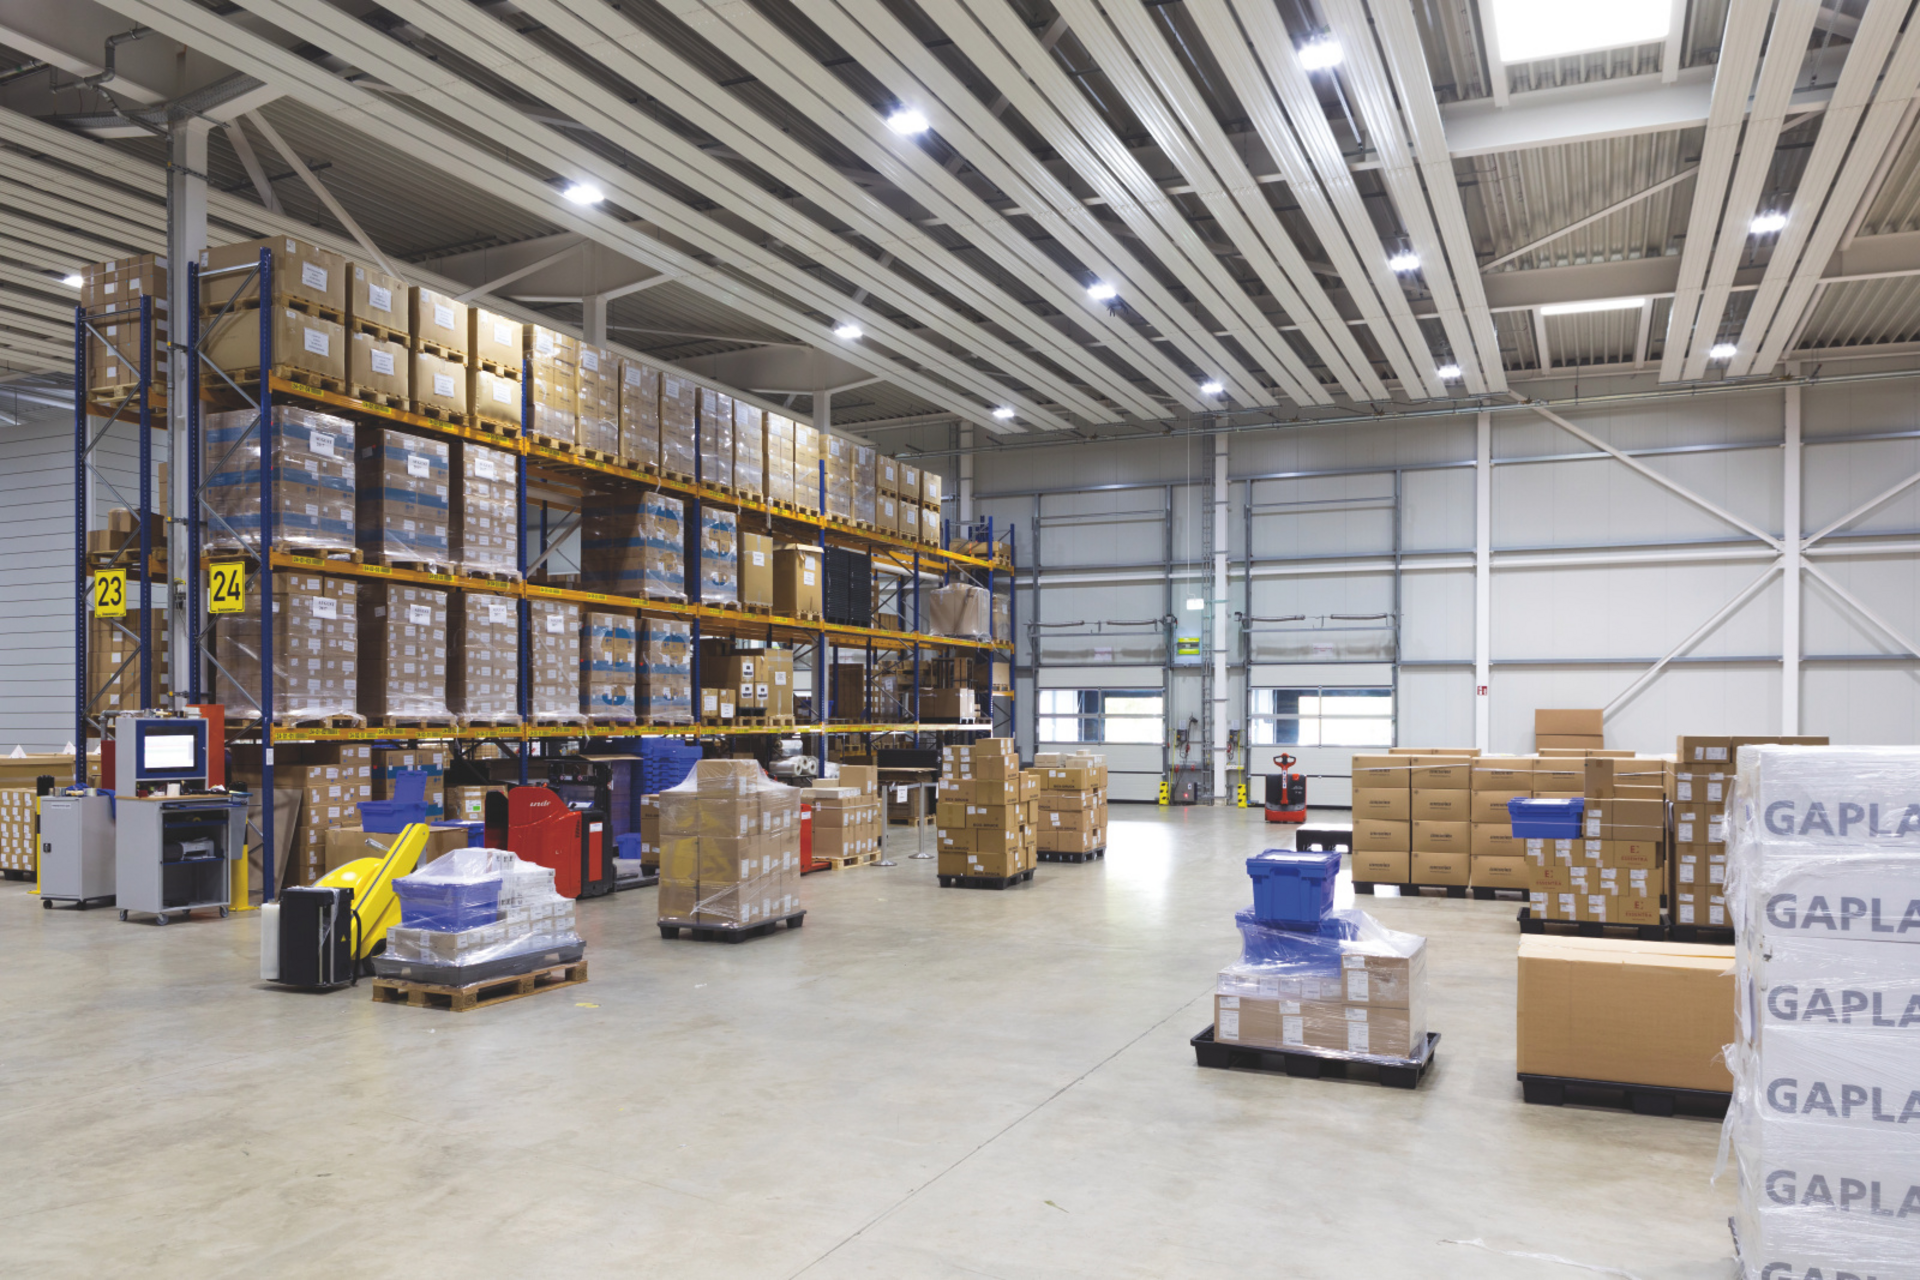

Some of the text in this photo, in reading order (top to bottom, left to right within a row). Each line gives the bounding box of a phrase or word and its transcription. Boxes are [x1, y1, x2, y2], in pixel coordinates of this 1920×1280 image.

[98, 576, 122, 606] 23
[213, 570, 241, 601] 24
[1764, 800, 1920, 838] GAPLA
[1766, 893, 1920, 934] GAPLA
[1767, 985, 1920, 1028] GAPLA
[1766, 1078, 1920, 1124] GAPLA
[1765, 1169, 1920, 1218] GAPLA
